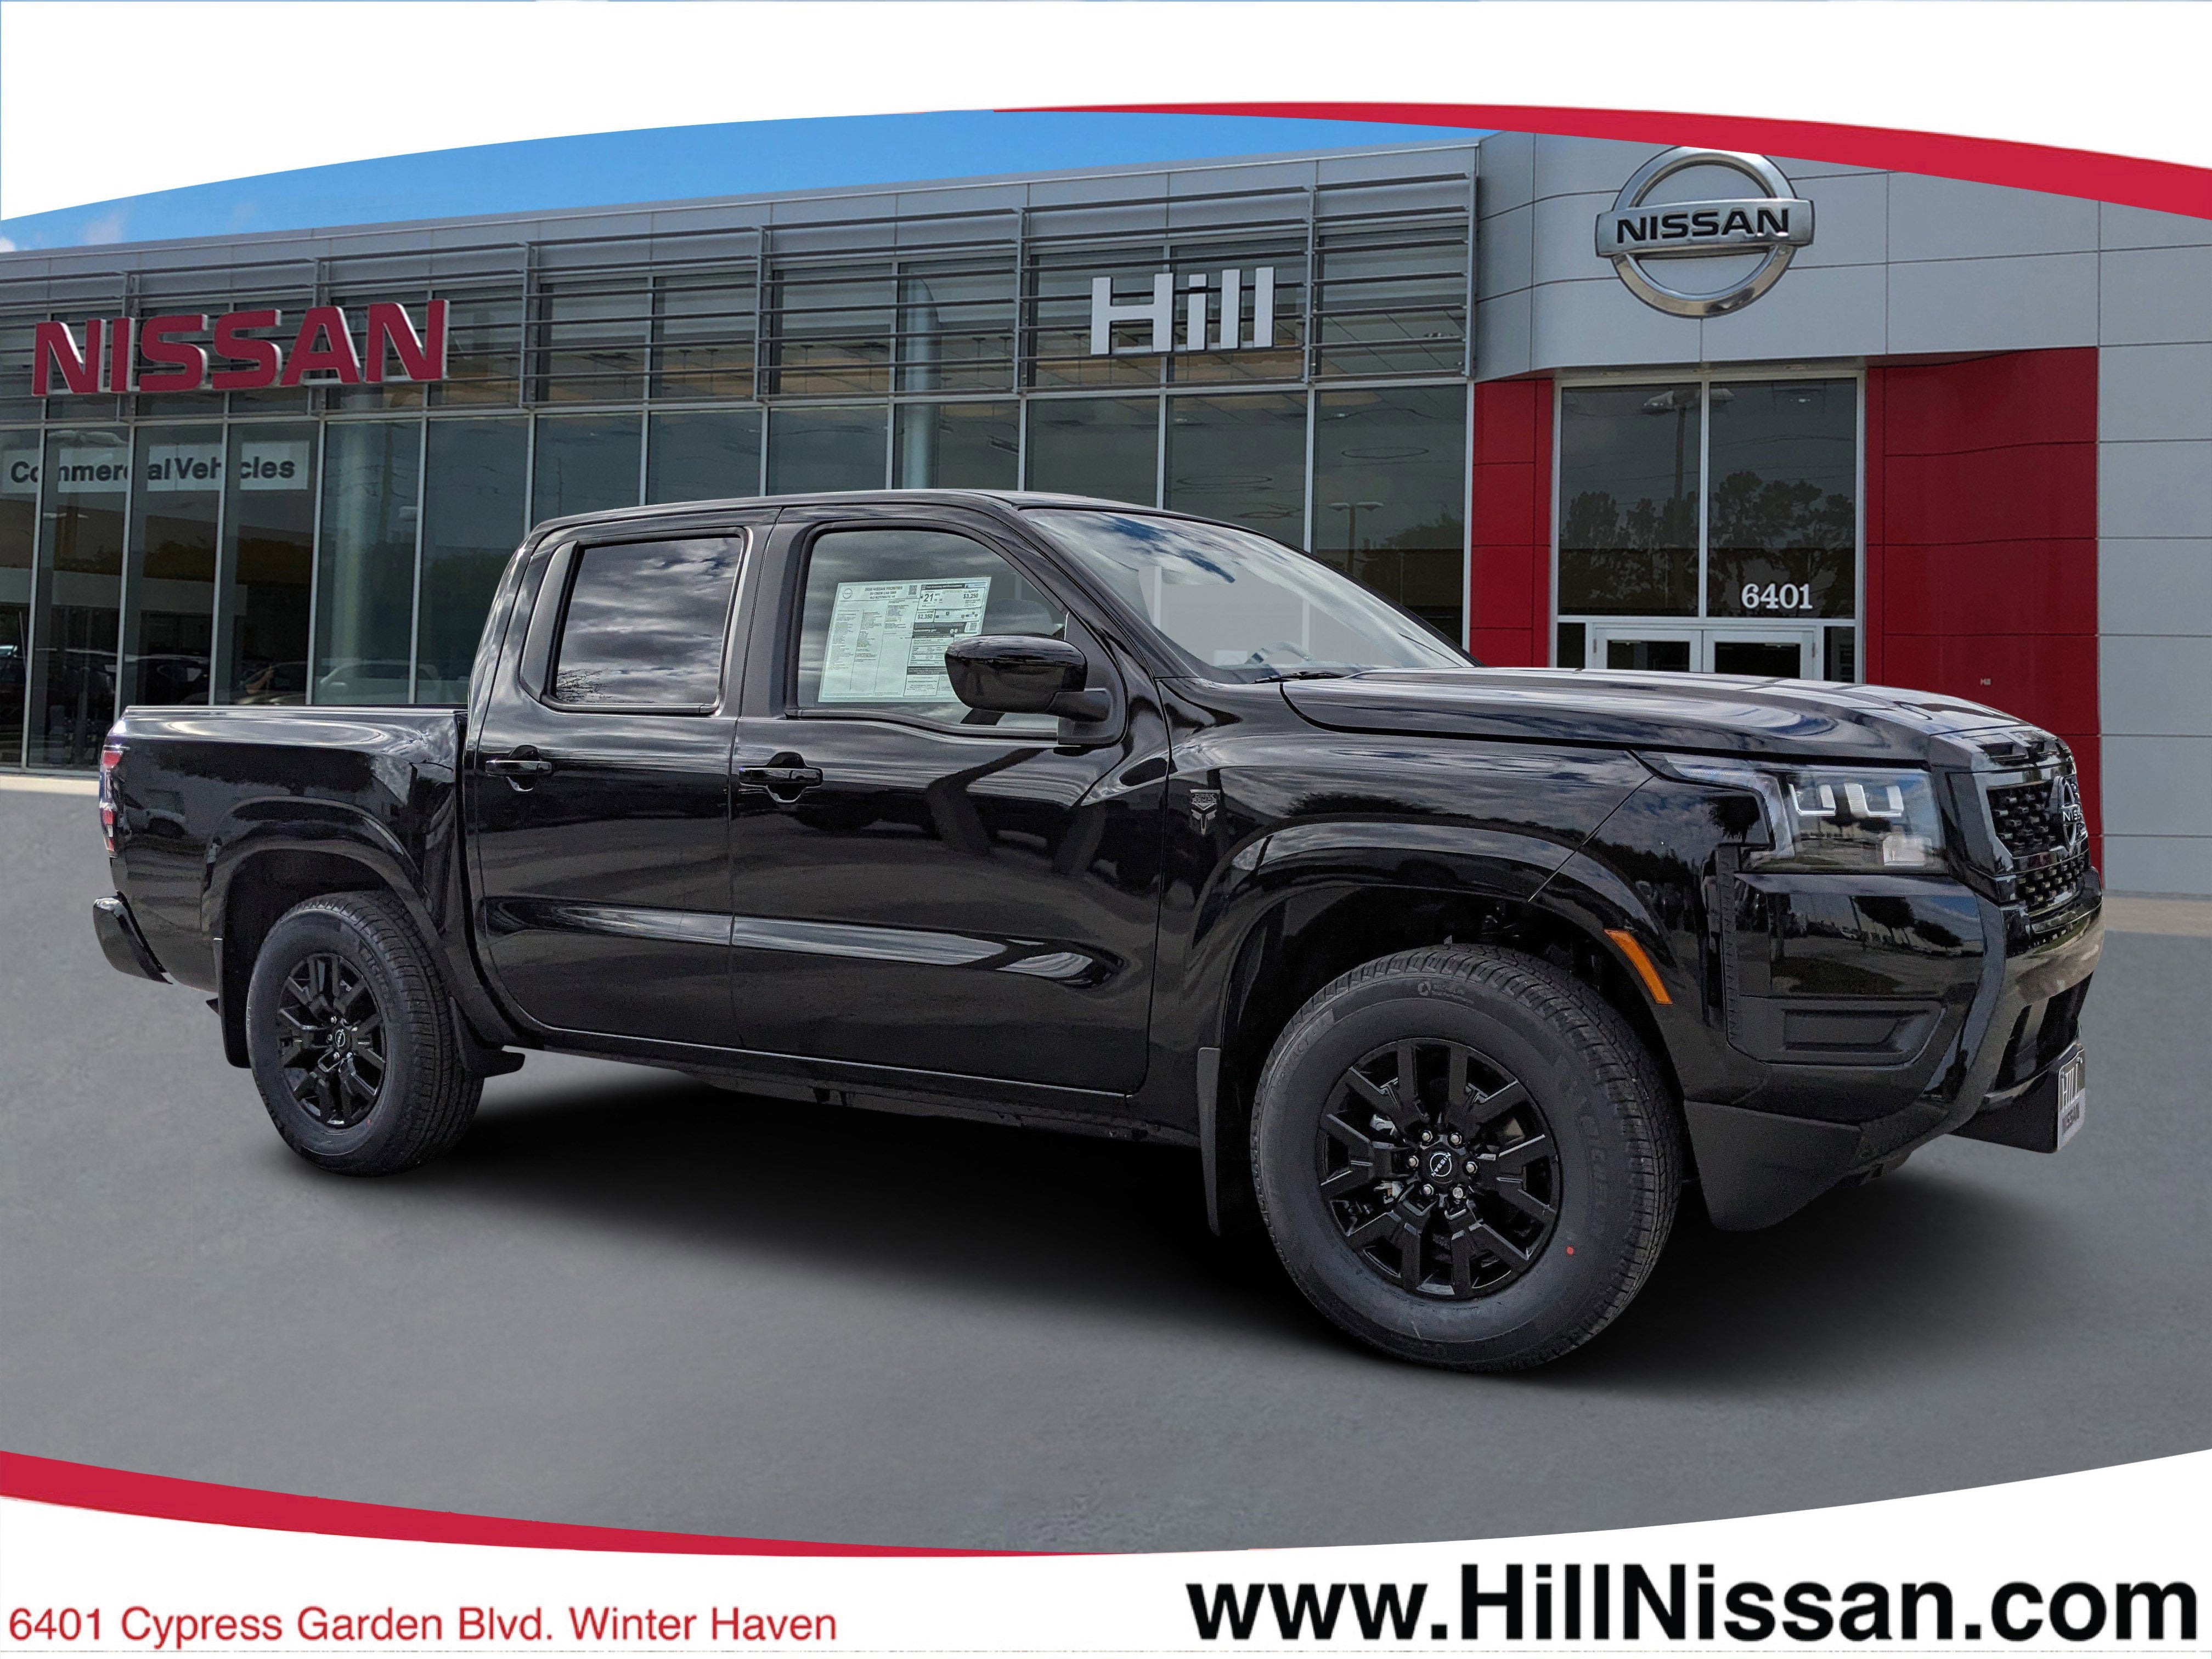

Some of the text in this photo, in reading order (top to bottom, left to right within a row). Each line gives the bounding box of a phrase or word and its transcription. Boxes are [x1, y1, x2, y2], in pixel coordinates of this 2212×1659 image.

[1617, 207, 1789, 244] NISSAN
[1091, 267, 1274, 355] Hill
[32, 300, 448, 396] NISSAN
[10, 456, 295, 483] Commeral Vehcles
[923, 593, 934, 602] 21
[1741, 583, 1813, 609] 6401
[1431, 1152, 1452, 1177] NISSAN
